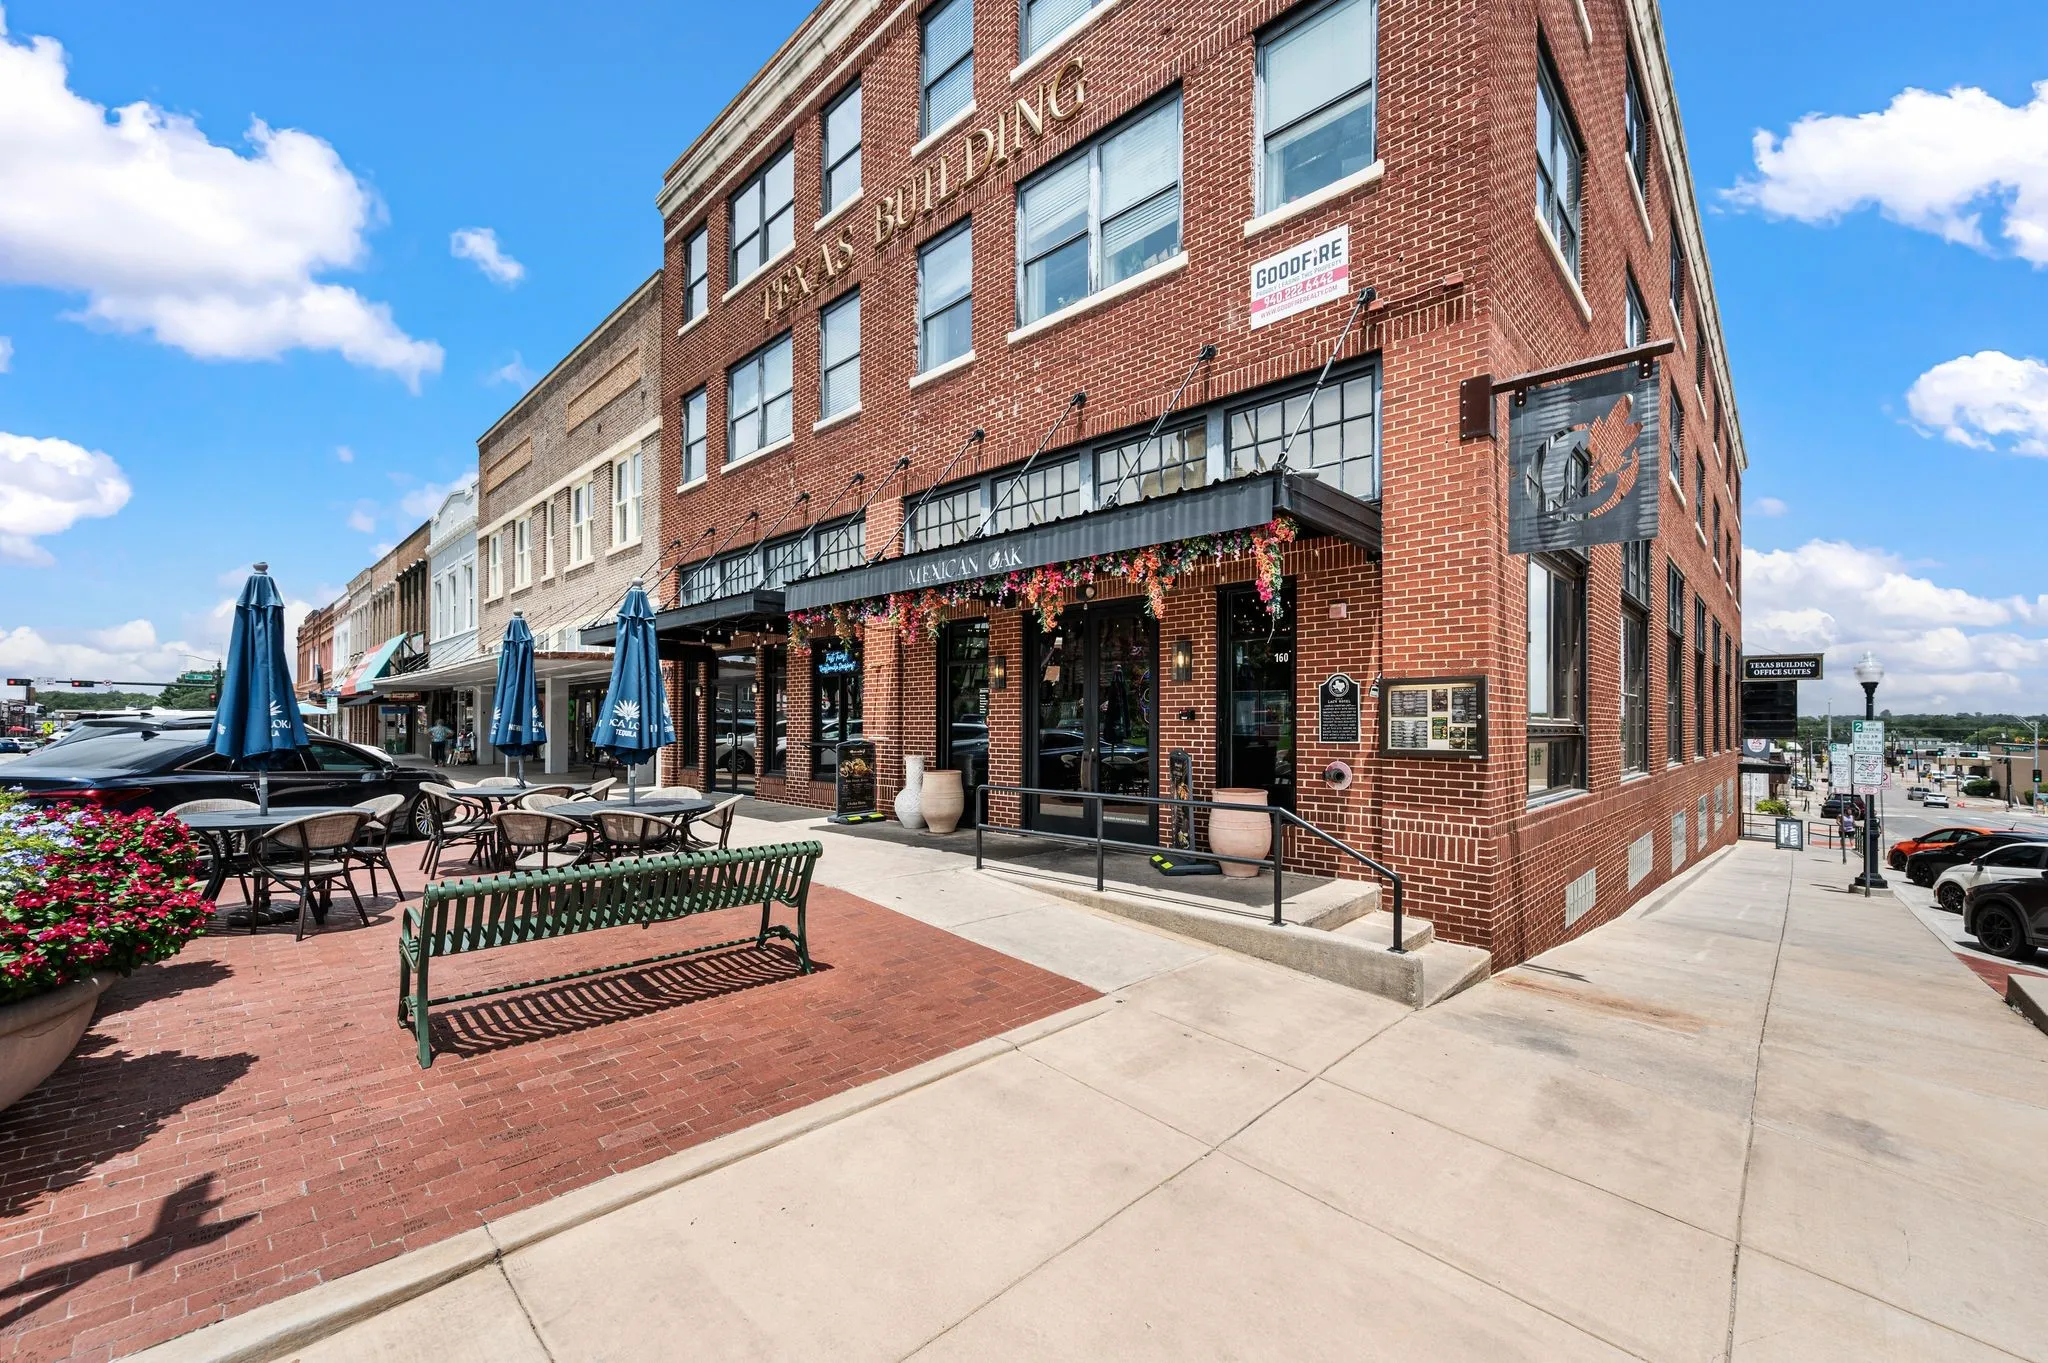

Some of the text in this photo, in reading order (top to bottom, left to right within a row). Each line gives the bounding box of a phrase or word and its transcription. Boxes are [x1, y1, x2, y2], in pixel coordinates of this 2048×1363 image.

[763, 56, 1088, 321] TEXAS BUILDING
[908, 552, 978, 586] MEXICAN
[1274, 652, 1289, 663] 160
[616, 729, 637, 738] TEQUILA
[1855, 723, 1862, 731] 2
[183, 1244, 258, 1273] SOROPTIMIST
